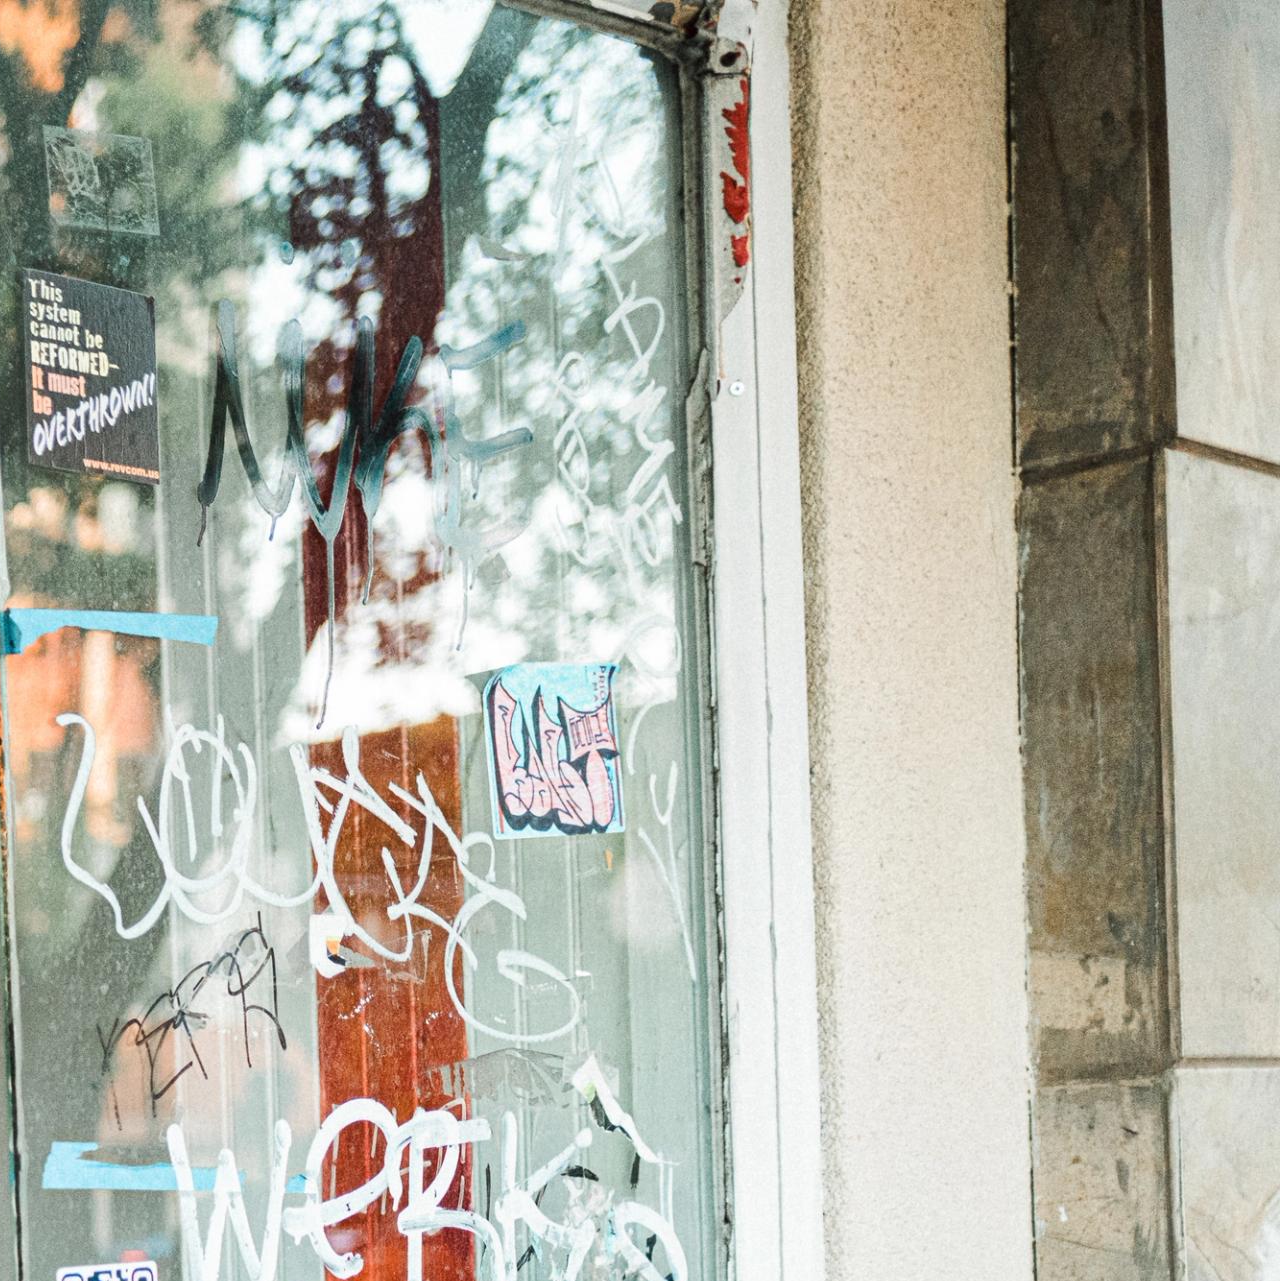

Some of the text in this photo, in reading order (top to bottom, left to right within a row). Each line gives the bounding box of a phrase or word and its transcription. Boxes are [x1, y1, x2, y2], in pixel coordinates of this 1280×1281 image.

[28, 278, 64, 302] This
[29, 302, 81, 326] system
[30, 321, 103, 349] cannot be
[32, 365, 87, 398] It must
[32, 389, 53, 415] be
[33, 372, 156, 456] OVERTHROWN!
[83, 458, 160, 479] www.revcom.us
